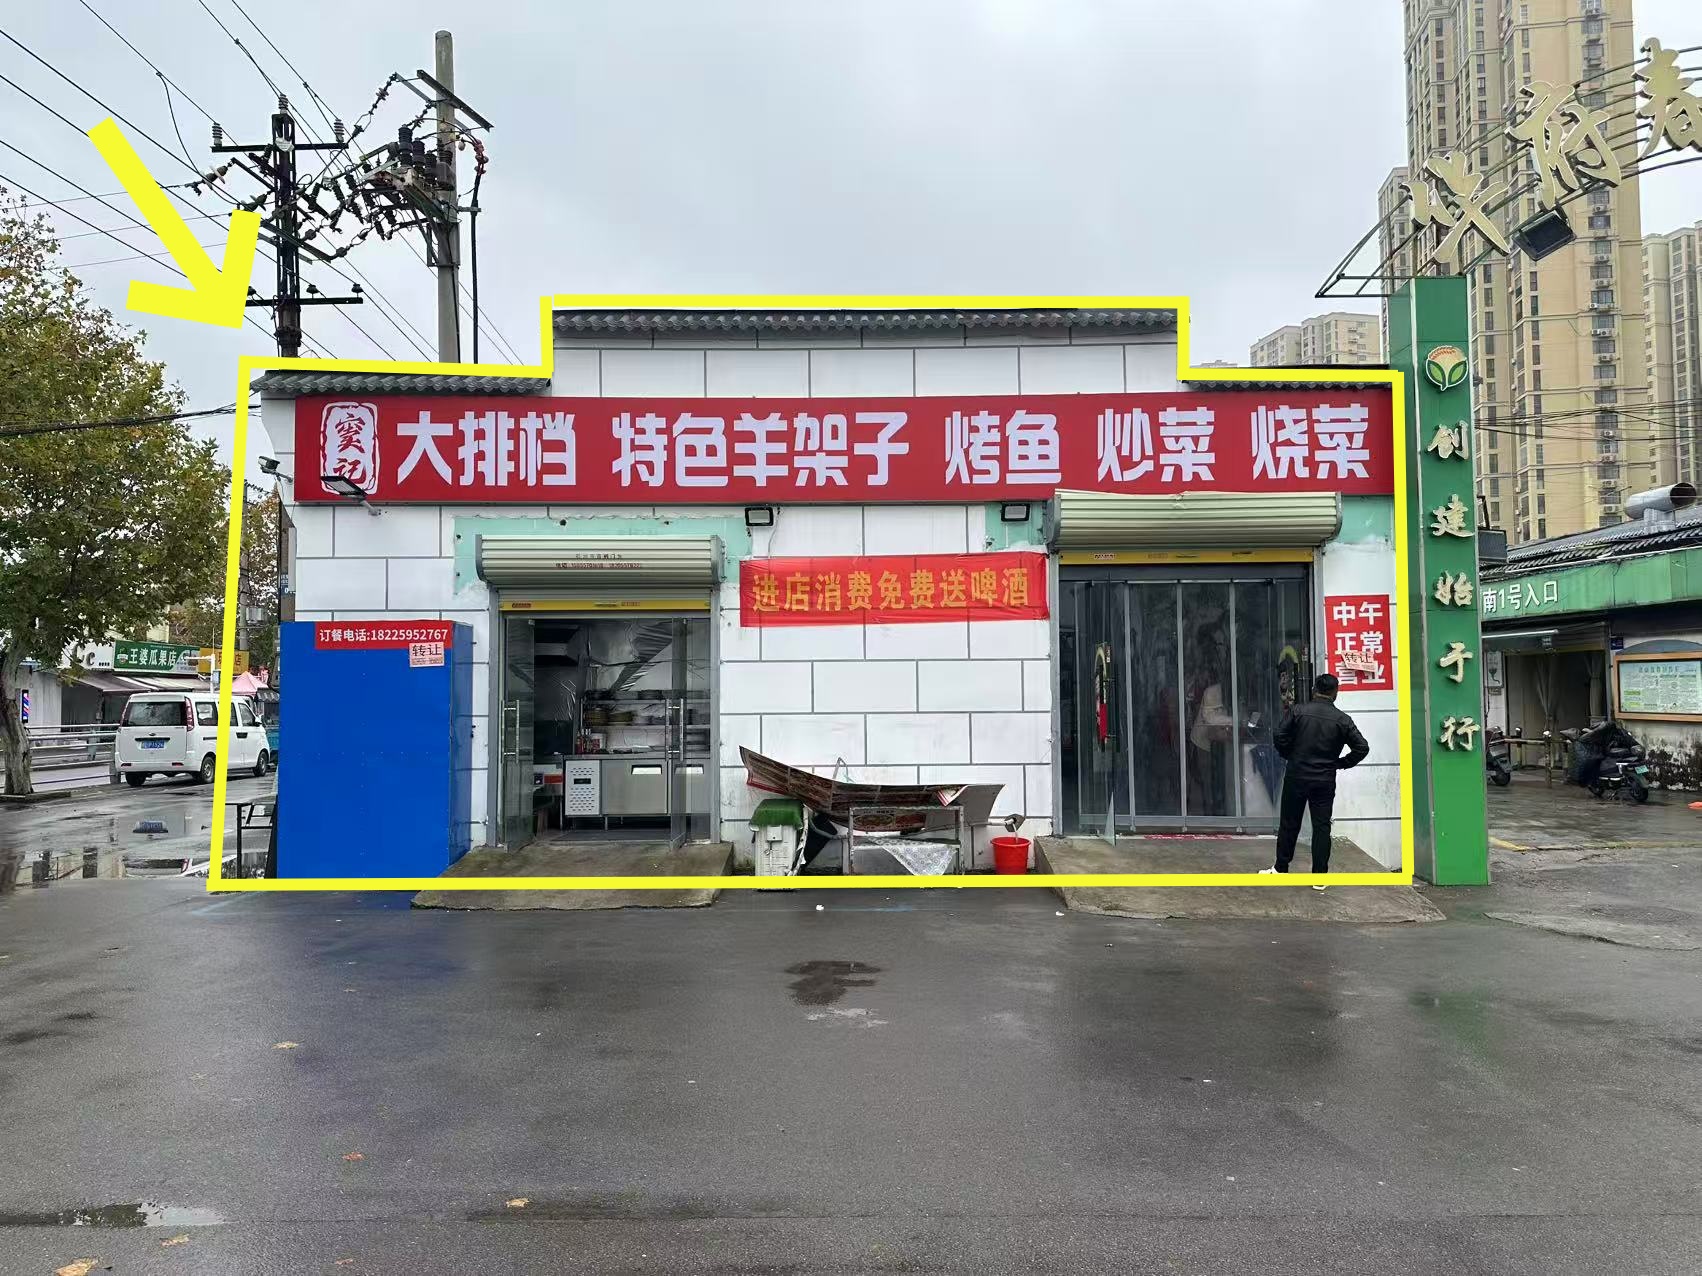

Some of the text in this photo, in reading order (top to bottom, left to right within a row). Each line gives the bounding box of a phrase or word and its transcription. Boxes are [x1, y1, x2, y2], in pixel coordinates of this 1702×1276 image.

[396, 403, 1370, 487] 大排档 特色羊架子 烤鱼 炒菜 烧菜
[752, 566, 1030, 612] 进店消费免费送啤酒
[1482, 580, 1559, 613] 南1号入口
[1332, 601, 1383, 626] 中午
[319, 629, 448, 642] 订餐电话:18225952767
[1334, 630, 1384, 655] 正常
[412, 643, 442, 657] 转让
